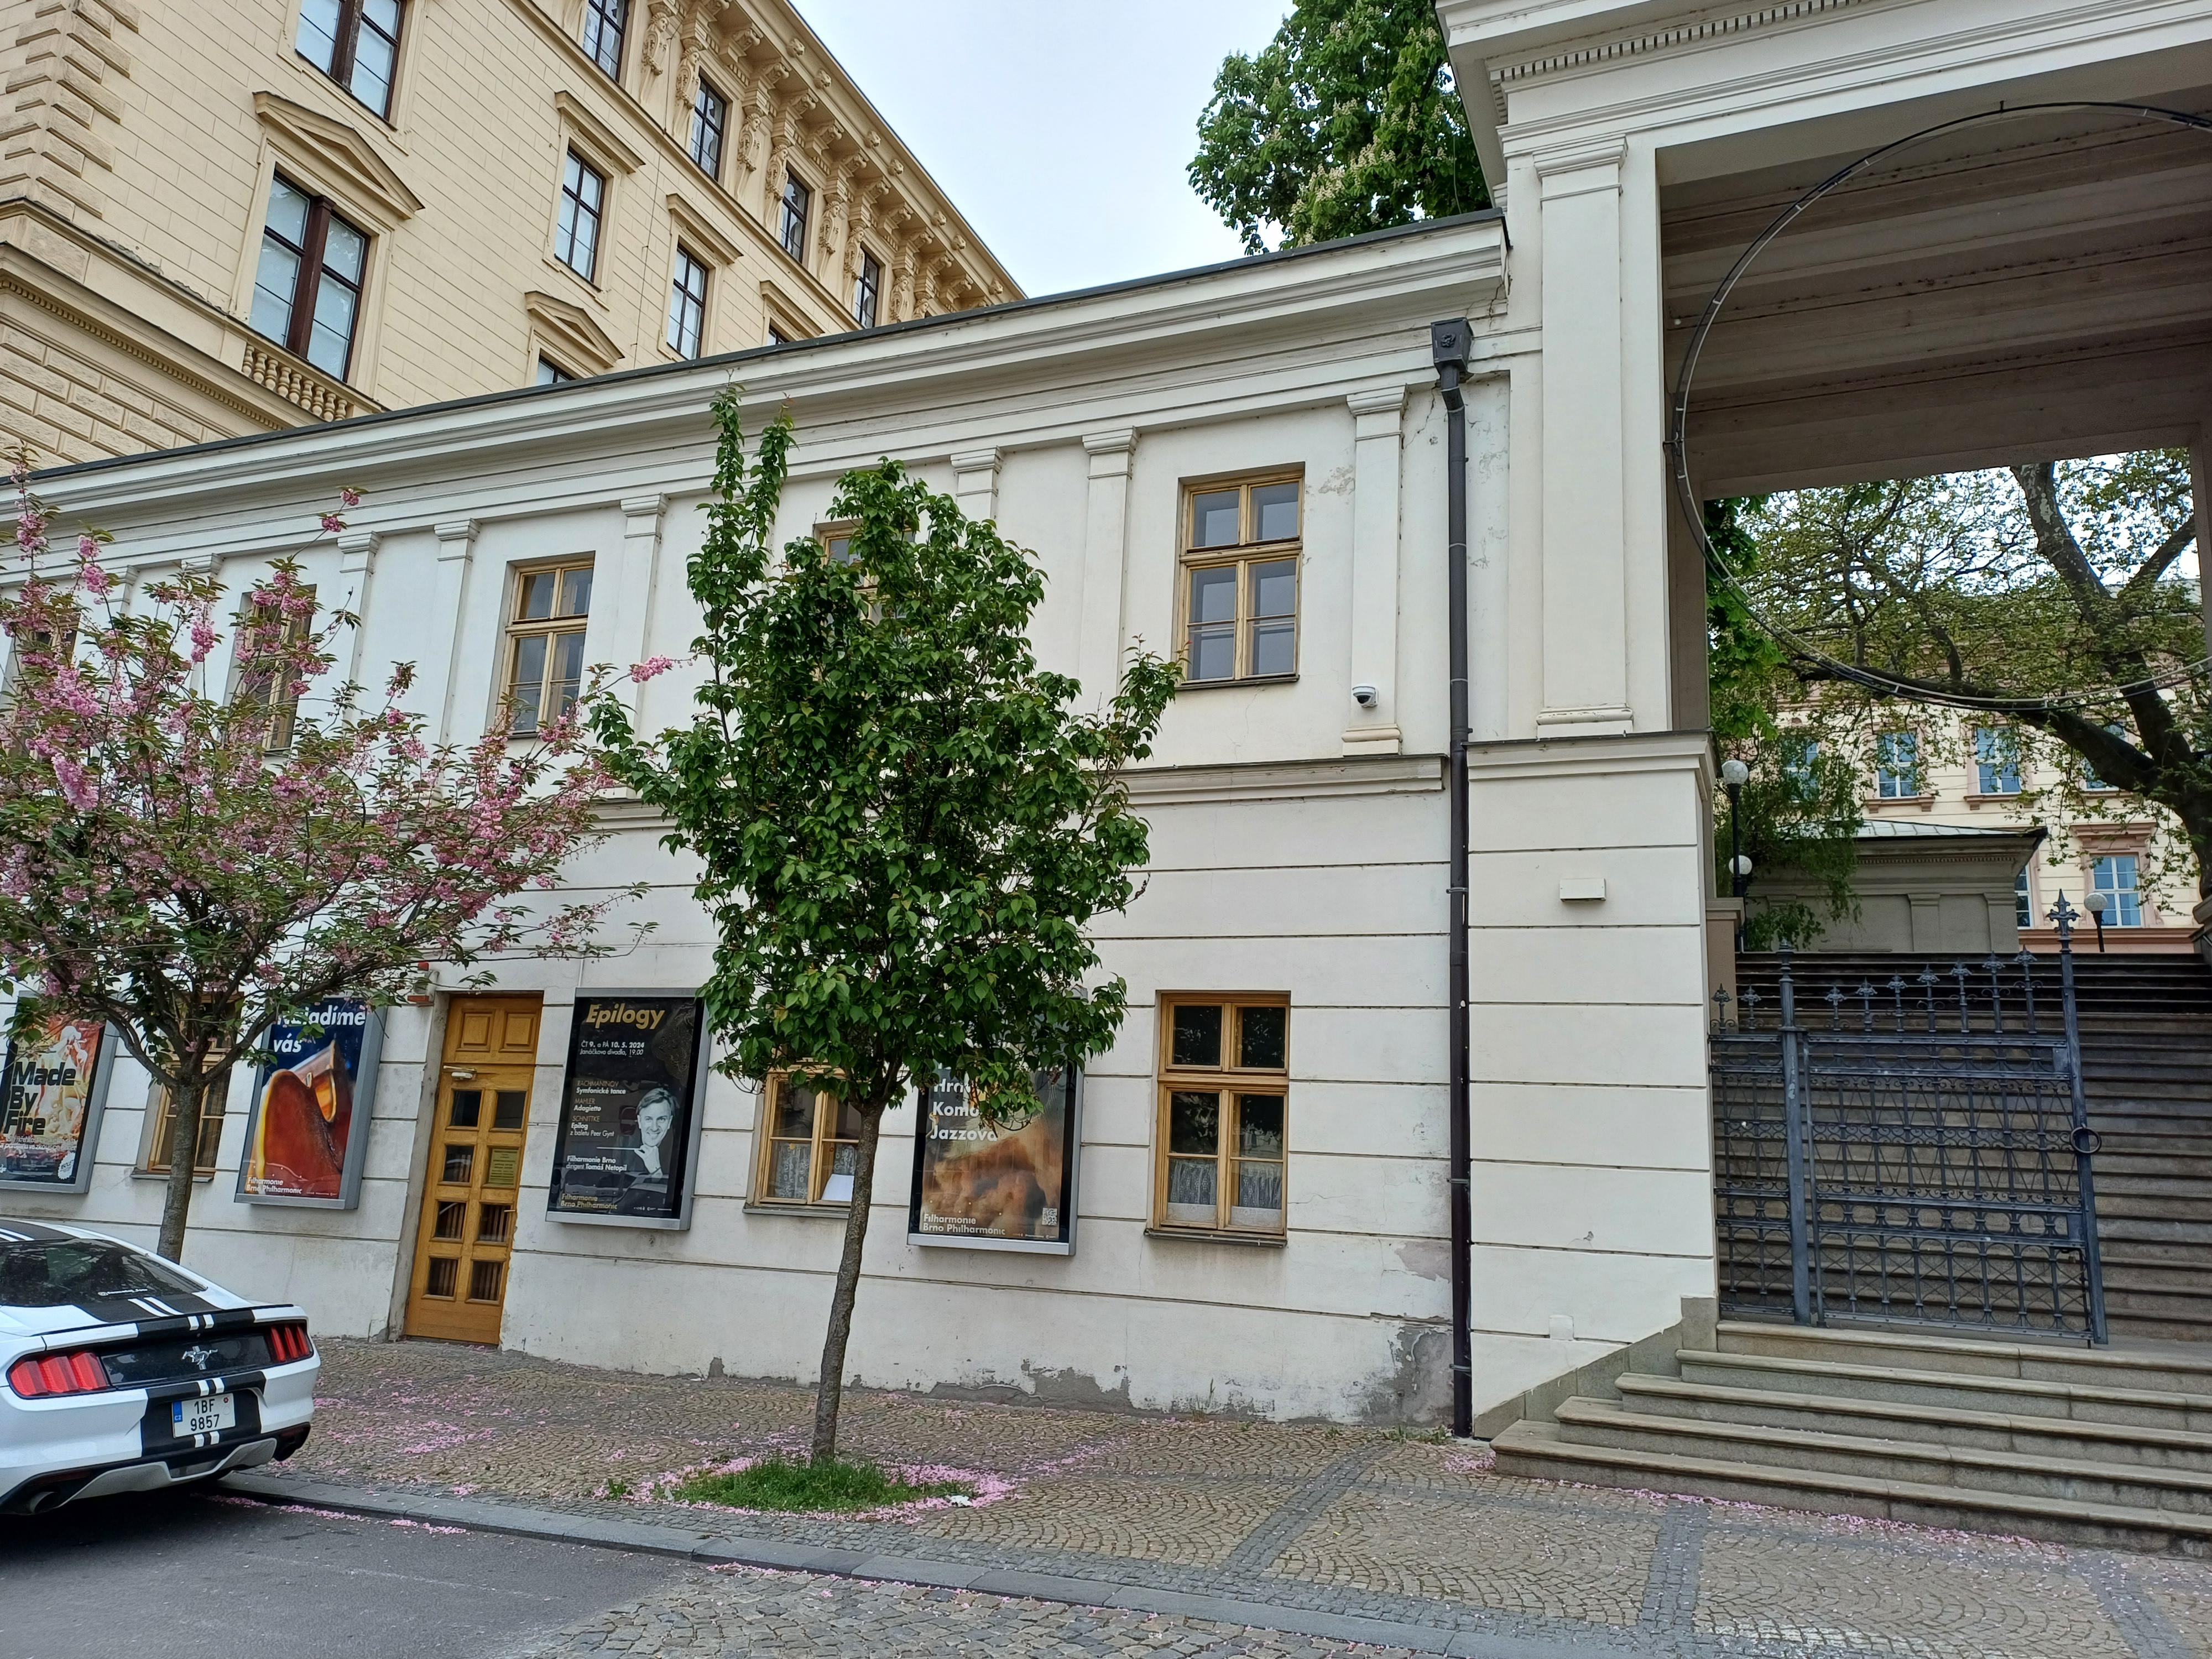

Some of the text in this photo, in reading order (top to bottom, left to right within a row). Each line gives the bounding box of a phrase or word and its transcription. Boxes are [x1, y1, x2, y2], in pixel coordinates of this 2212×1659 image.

[586, 1003, 665, 1030] Epilogy
[273, 1032, 302, 1053] vás
[12, 1061, 76, 1086] Made
[9, 1086, 39, 1117] By
[932, 1101, 981, 1117] Komo
[3, 1110, 46, 1135] Fire
[571, 1122, 588, 1130] Epilog
[602, 1130, 614, 1138] Gynt
[605, 1164, 627, 1172] Netopil
[248, 1177, 284, 1186] Filharmonie
[263, 1186, 302, 1194] Philharmonic
[577, 1201, 618, 1209] Philharmonic
[923, 1213, 977, 1224] Filharmonie
[922, 1223, 1005, 1235] Brno Philharmonic
[194, 1399, 215, 1415] 1BF
[190, 1414, 220, 1431] 9857
